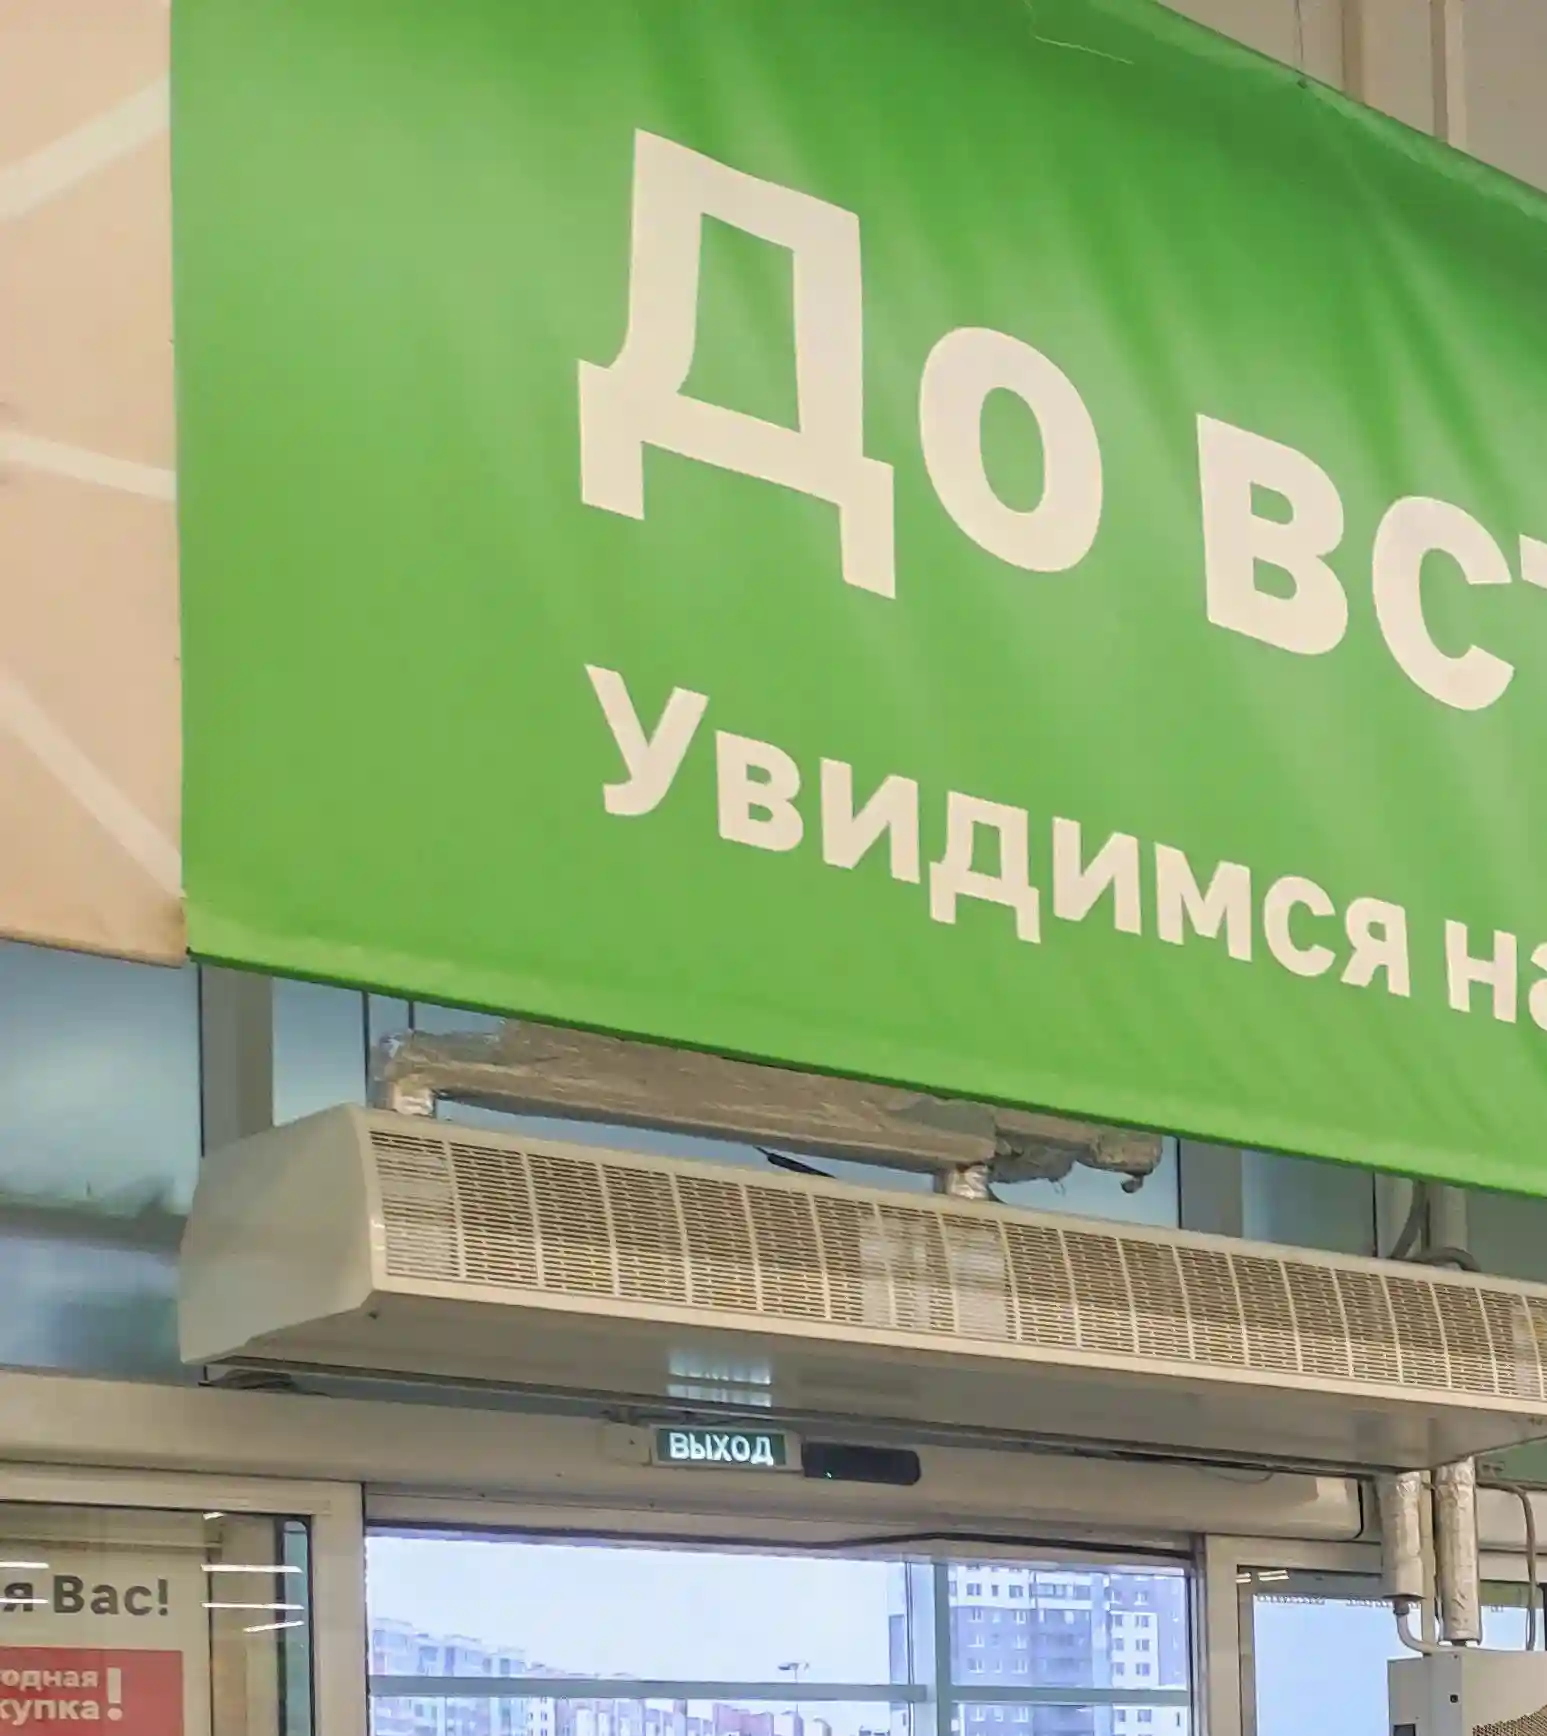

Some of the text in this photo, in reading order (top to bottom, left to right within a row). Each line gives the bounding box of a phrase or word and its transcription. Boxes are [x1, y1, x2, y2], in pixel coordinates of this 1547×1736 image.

[577, 129, 1103, 599] До
[585, 663, 1411, 998] Увидимся
[669, 1432, 773, 1466] ВЫХОД
[54, 1575, 168, 1616] Вас!
[0, 1669, 100, 1692] одная
